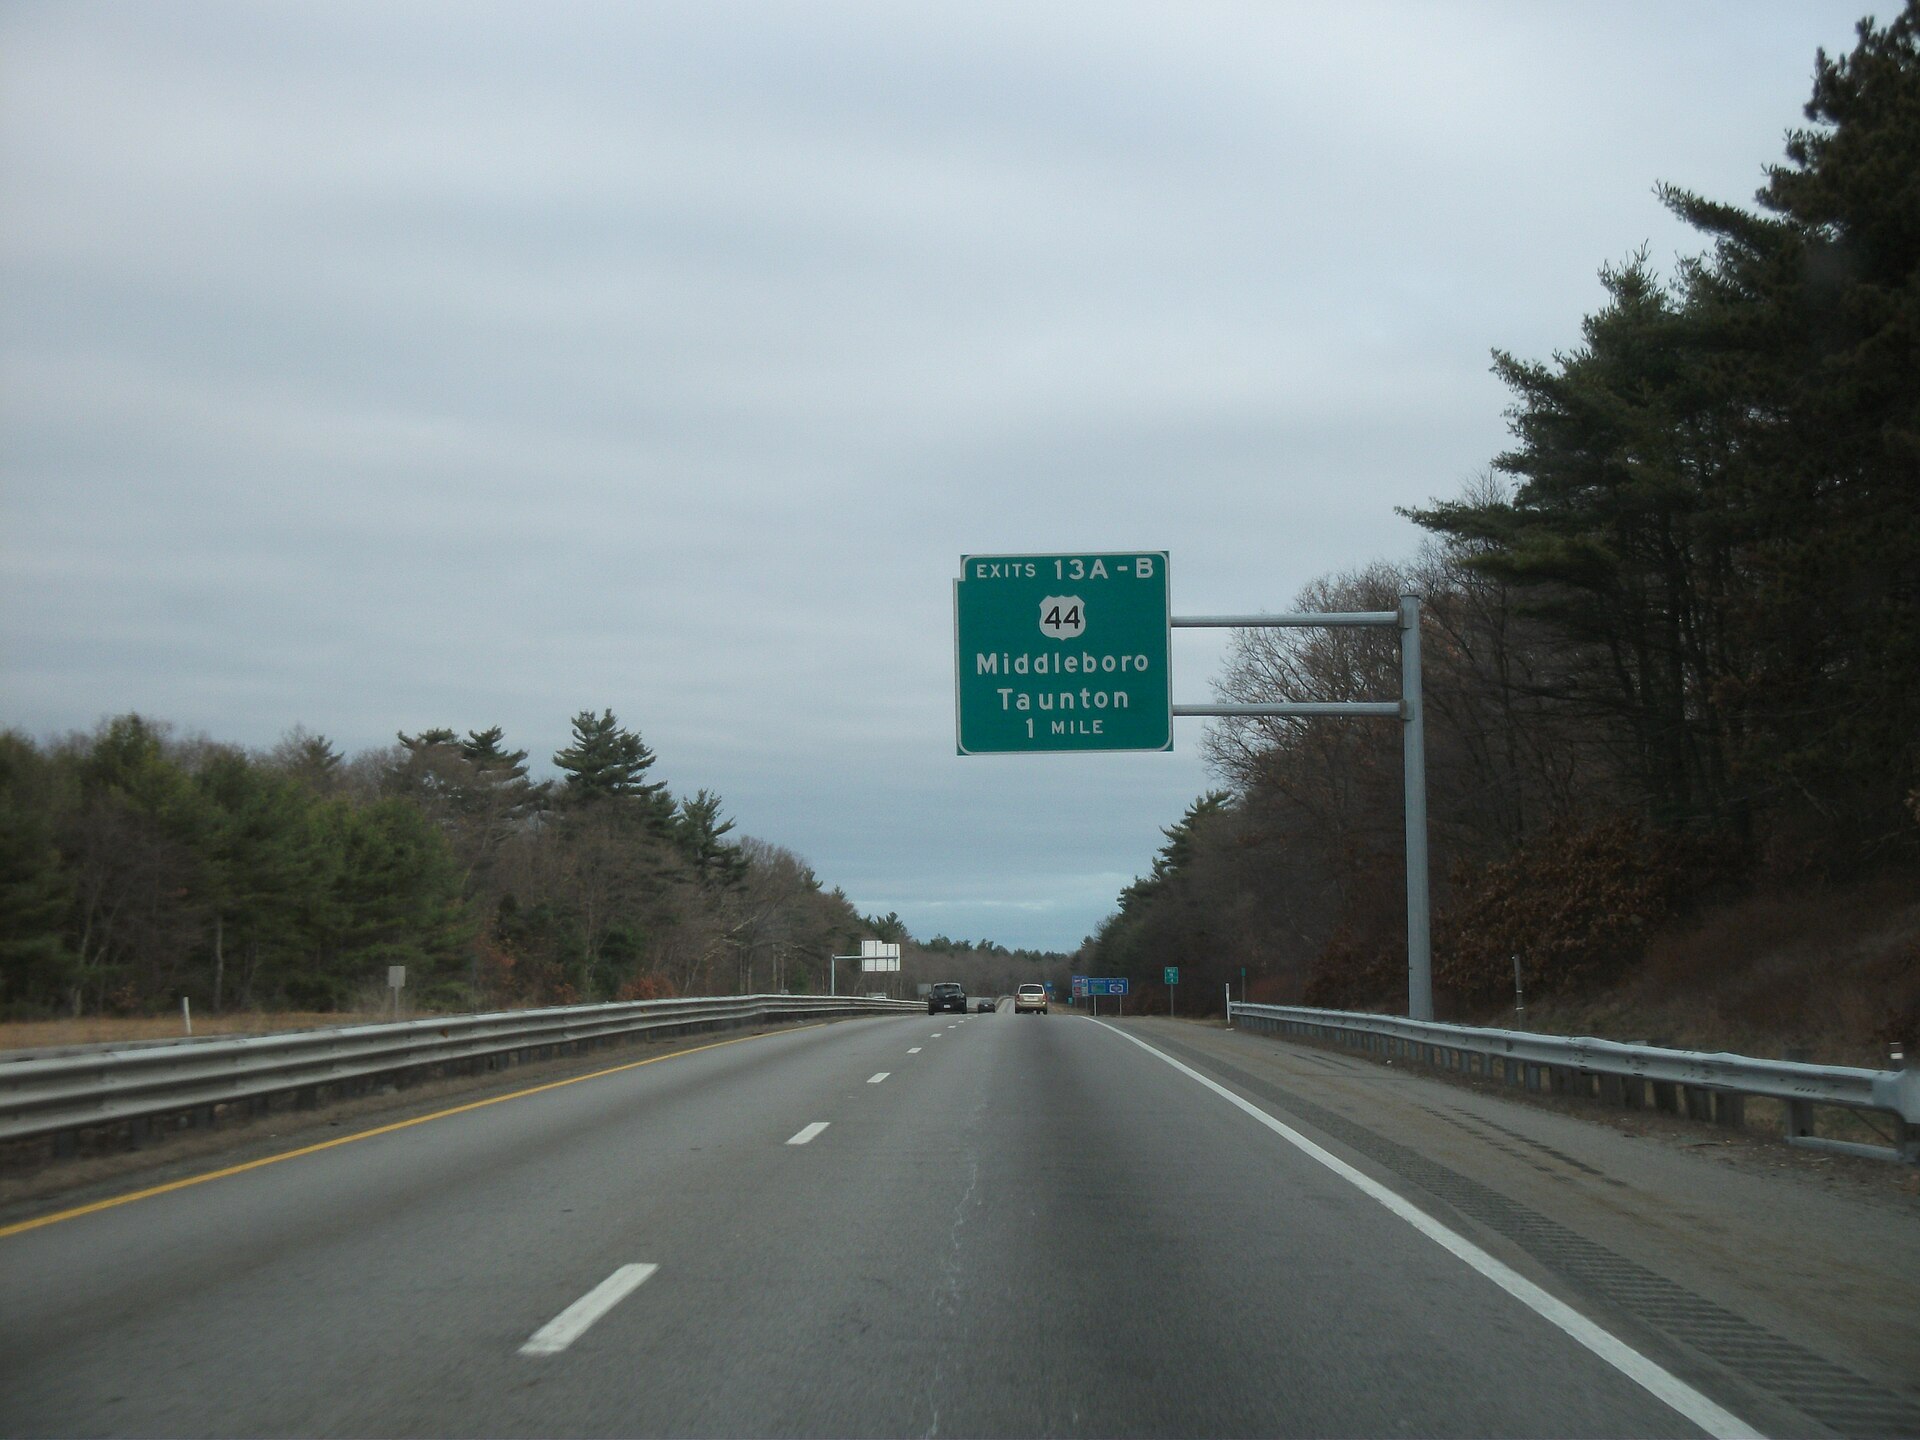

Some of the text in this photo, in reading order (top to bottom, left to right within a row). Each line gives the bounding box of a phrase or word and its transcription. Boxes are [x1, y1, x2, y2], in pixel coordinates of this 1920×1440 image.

[976, 563, 1036, 579] EXITS
[1044, 605, 1081, 630] 44
[976, 651, 1149, 675] Middleboro
[996, 687, 1129, 711] Taunton
[1025, 717, 1103, 739] 1 MILE
